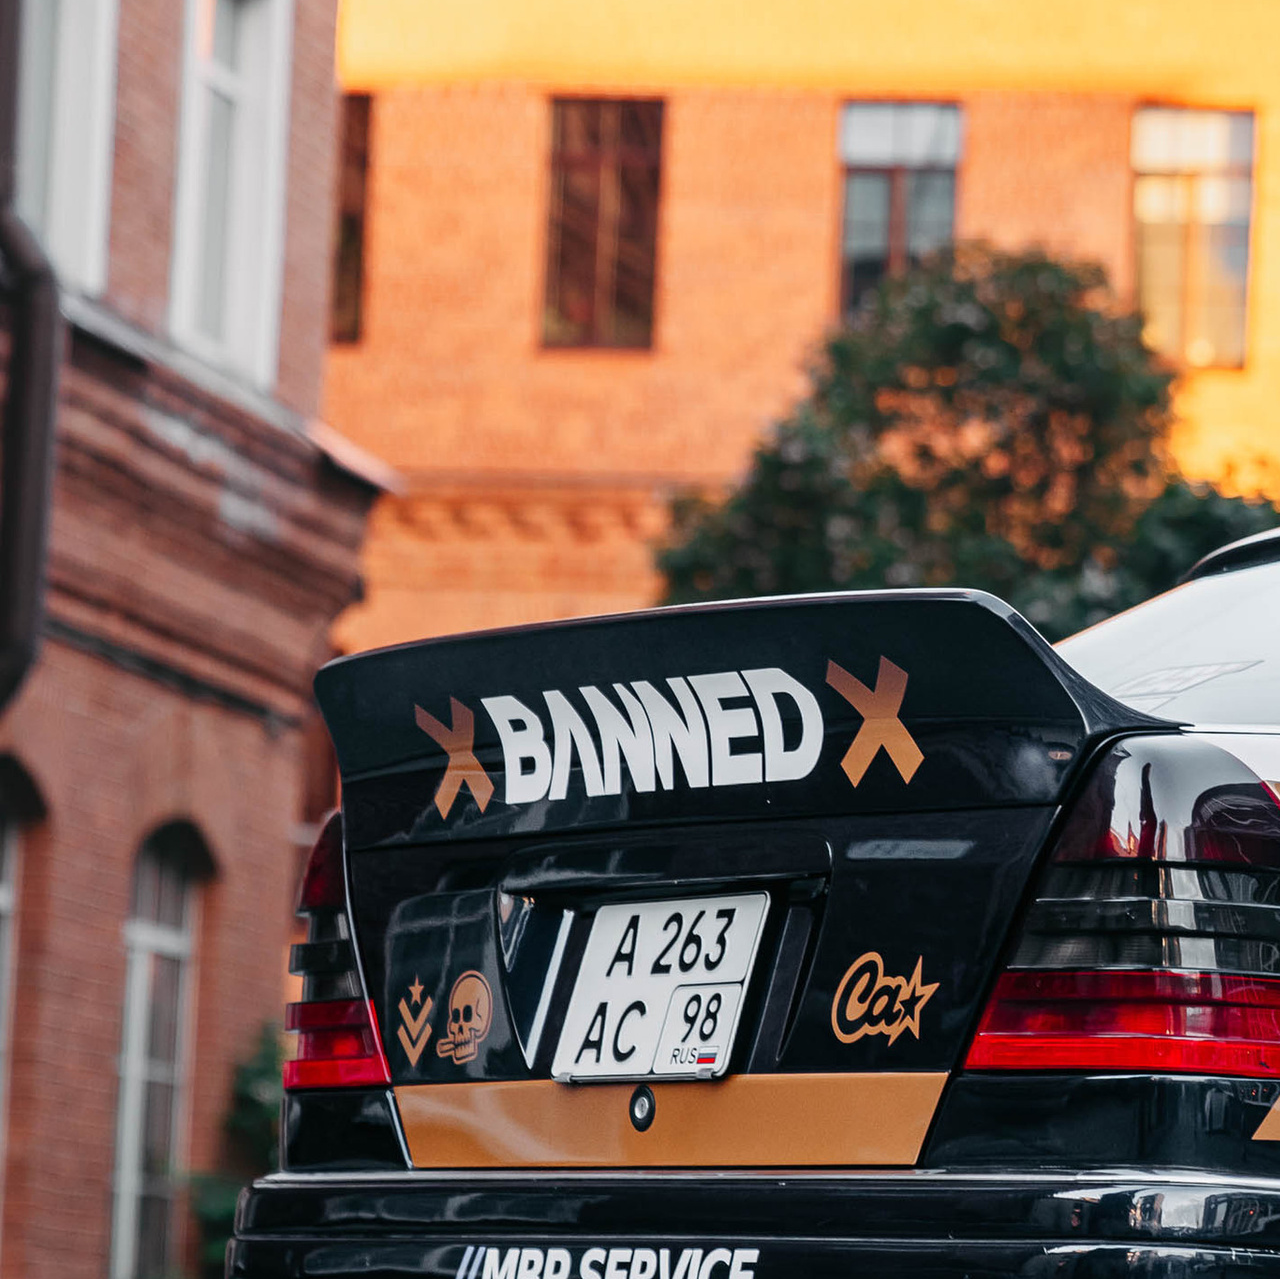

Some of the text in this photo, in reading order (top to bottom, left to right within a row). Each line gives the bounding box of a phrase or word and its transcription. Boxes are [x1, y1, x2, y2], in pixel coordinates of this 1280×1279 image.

[481, 667, 824, 804] BANNED
[606, 908, 736, 977] A 263
[574, 1000, 647, 1064] AC
[681, 992, 722, 1043] 98
[670, 1047, 698, 1064] RUS
